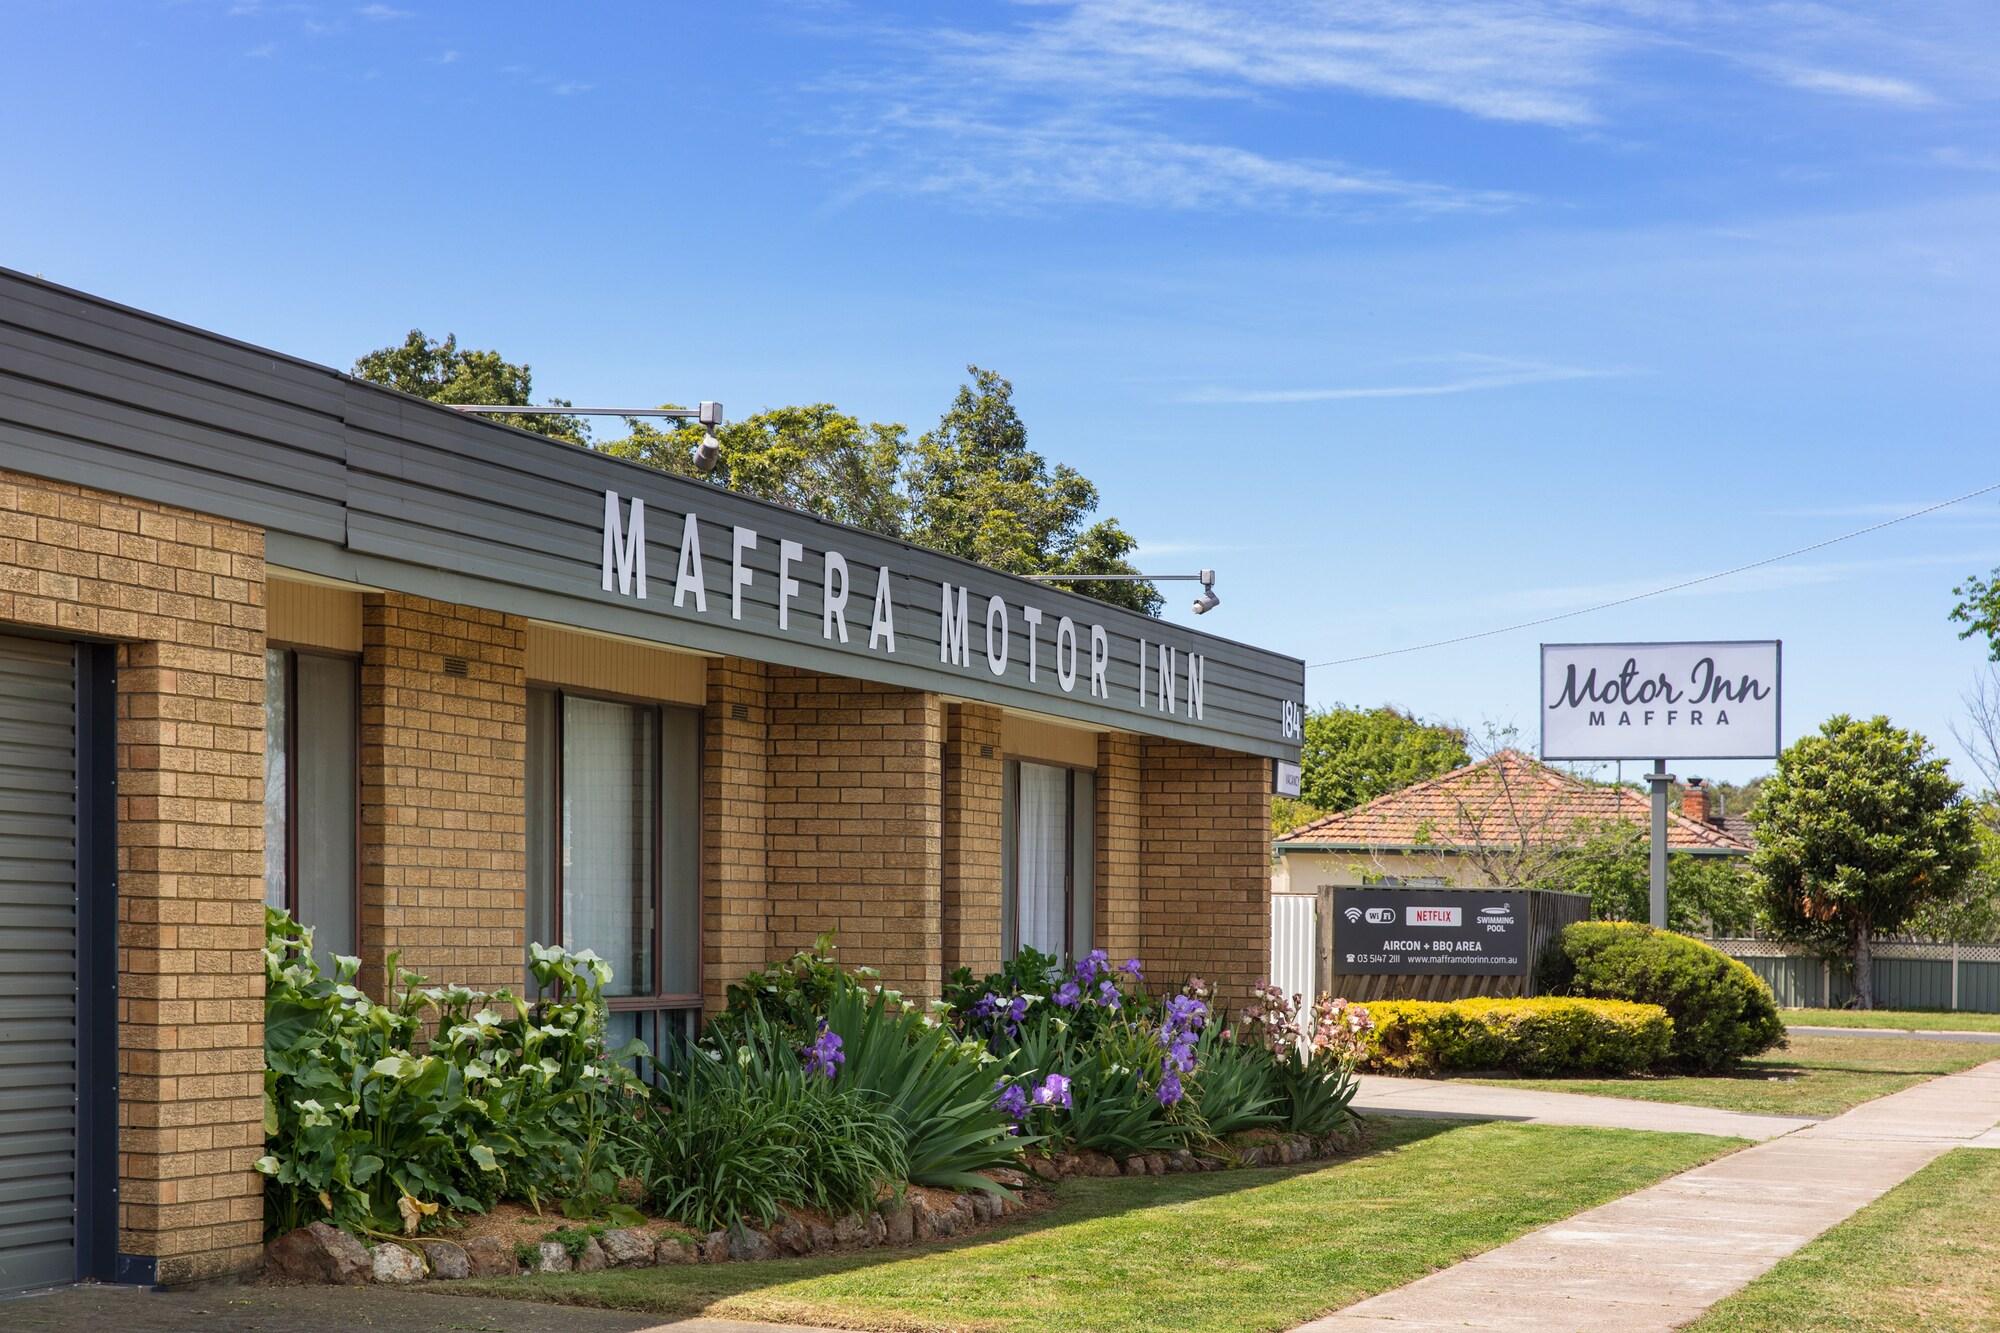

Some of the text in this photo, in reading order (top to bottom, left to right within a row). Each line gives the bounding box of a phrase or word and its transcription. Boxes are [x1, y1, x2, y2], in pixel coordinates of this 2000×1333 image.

[602, 490, 1205, 720] MAFFRA MOTOR INN
[1549, 657, 1771, 709] Motor Inn
[1282, 700, 1300, 739] 184
[1589, 710, 1729, 726] MAFFRA
[1416, 910, 1451, 922] NETFLIX
[1477, 916, 1514, 925] SWIMMING
[1383, 941, 1421, 951] AIRCON
[1433, 941, 1453, 952] BBQ
[1456, 941, 1482, 951] AREA
[1357, 954, 1517, 964] 03 5147 2111 www.mafframotorinn.com.au
